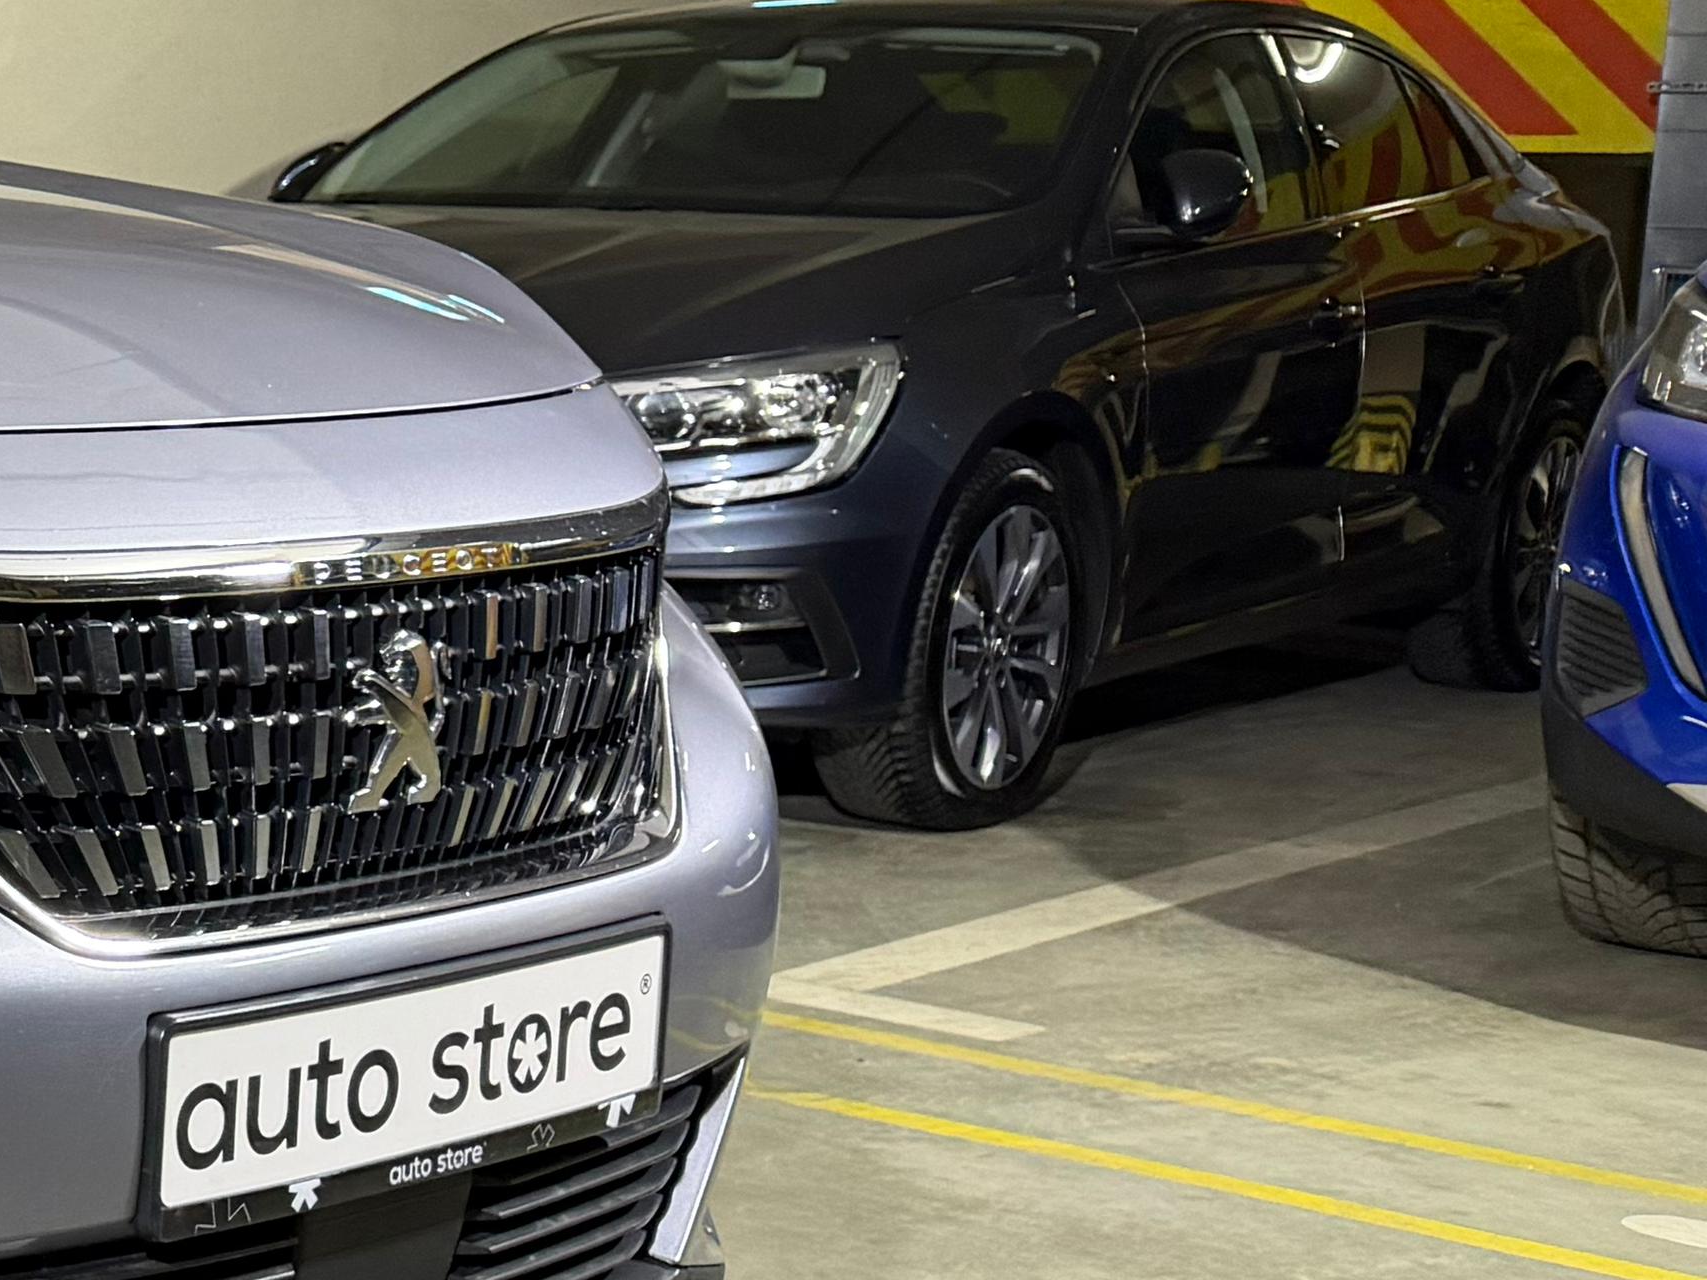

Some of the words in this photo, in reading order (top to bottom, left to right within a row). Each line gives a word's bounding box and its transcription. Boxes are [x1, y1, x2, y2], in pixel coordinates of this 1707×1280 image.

[175, 1038, 400, 1172] auto
[427, 991, 632, 1116] store
[389, 1155, 433, 1186] auto
[436, 1144, 484, 1174] store
